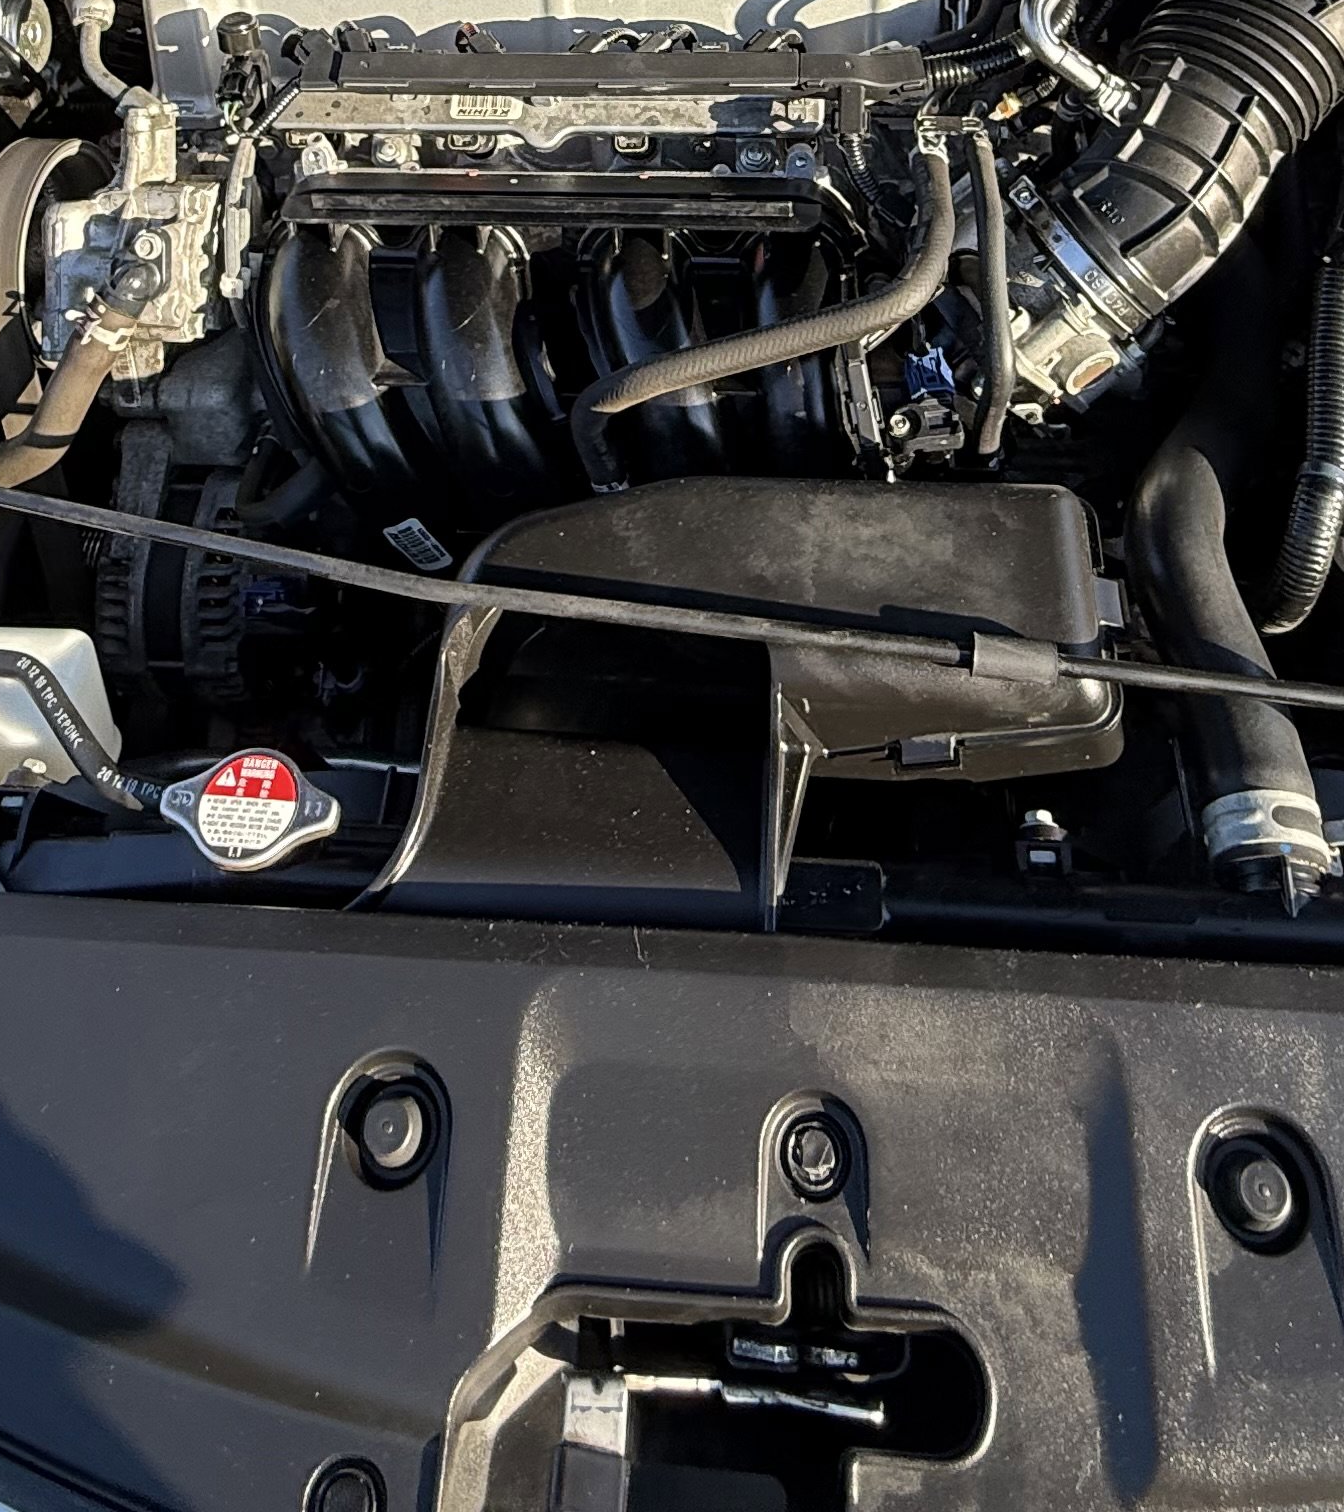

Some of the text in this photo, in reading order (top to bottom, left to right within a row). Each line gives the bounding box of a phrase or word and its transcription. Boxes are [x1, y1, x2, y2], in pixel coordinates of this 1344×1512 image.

[458, 109, 510, 117] KEIHIN
[16, 656, 31, 670] 20
[41, 686, 58, 708] TPC
[242, 758, 279, 769] DANGER
[96, 766, 113, 782] 20
[140, 782, 162, 799] TPC
